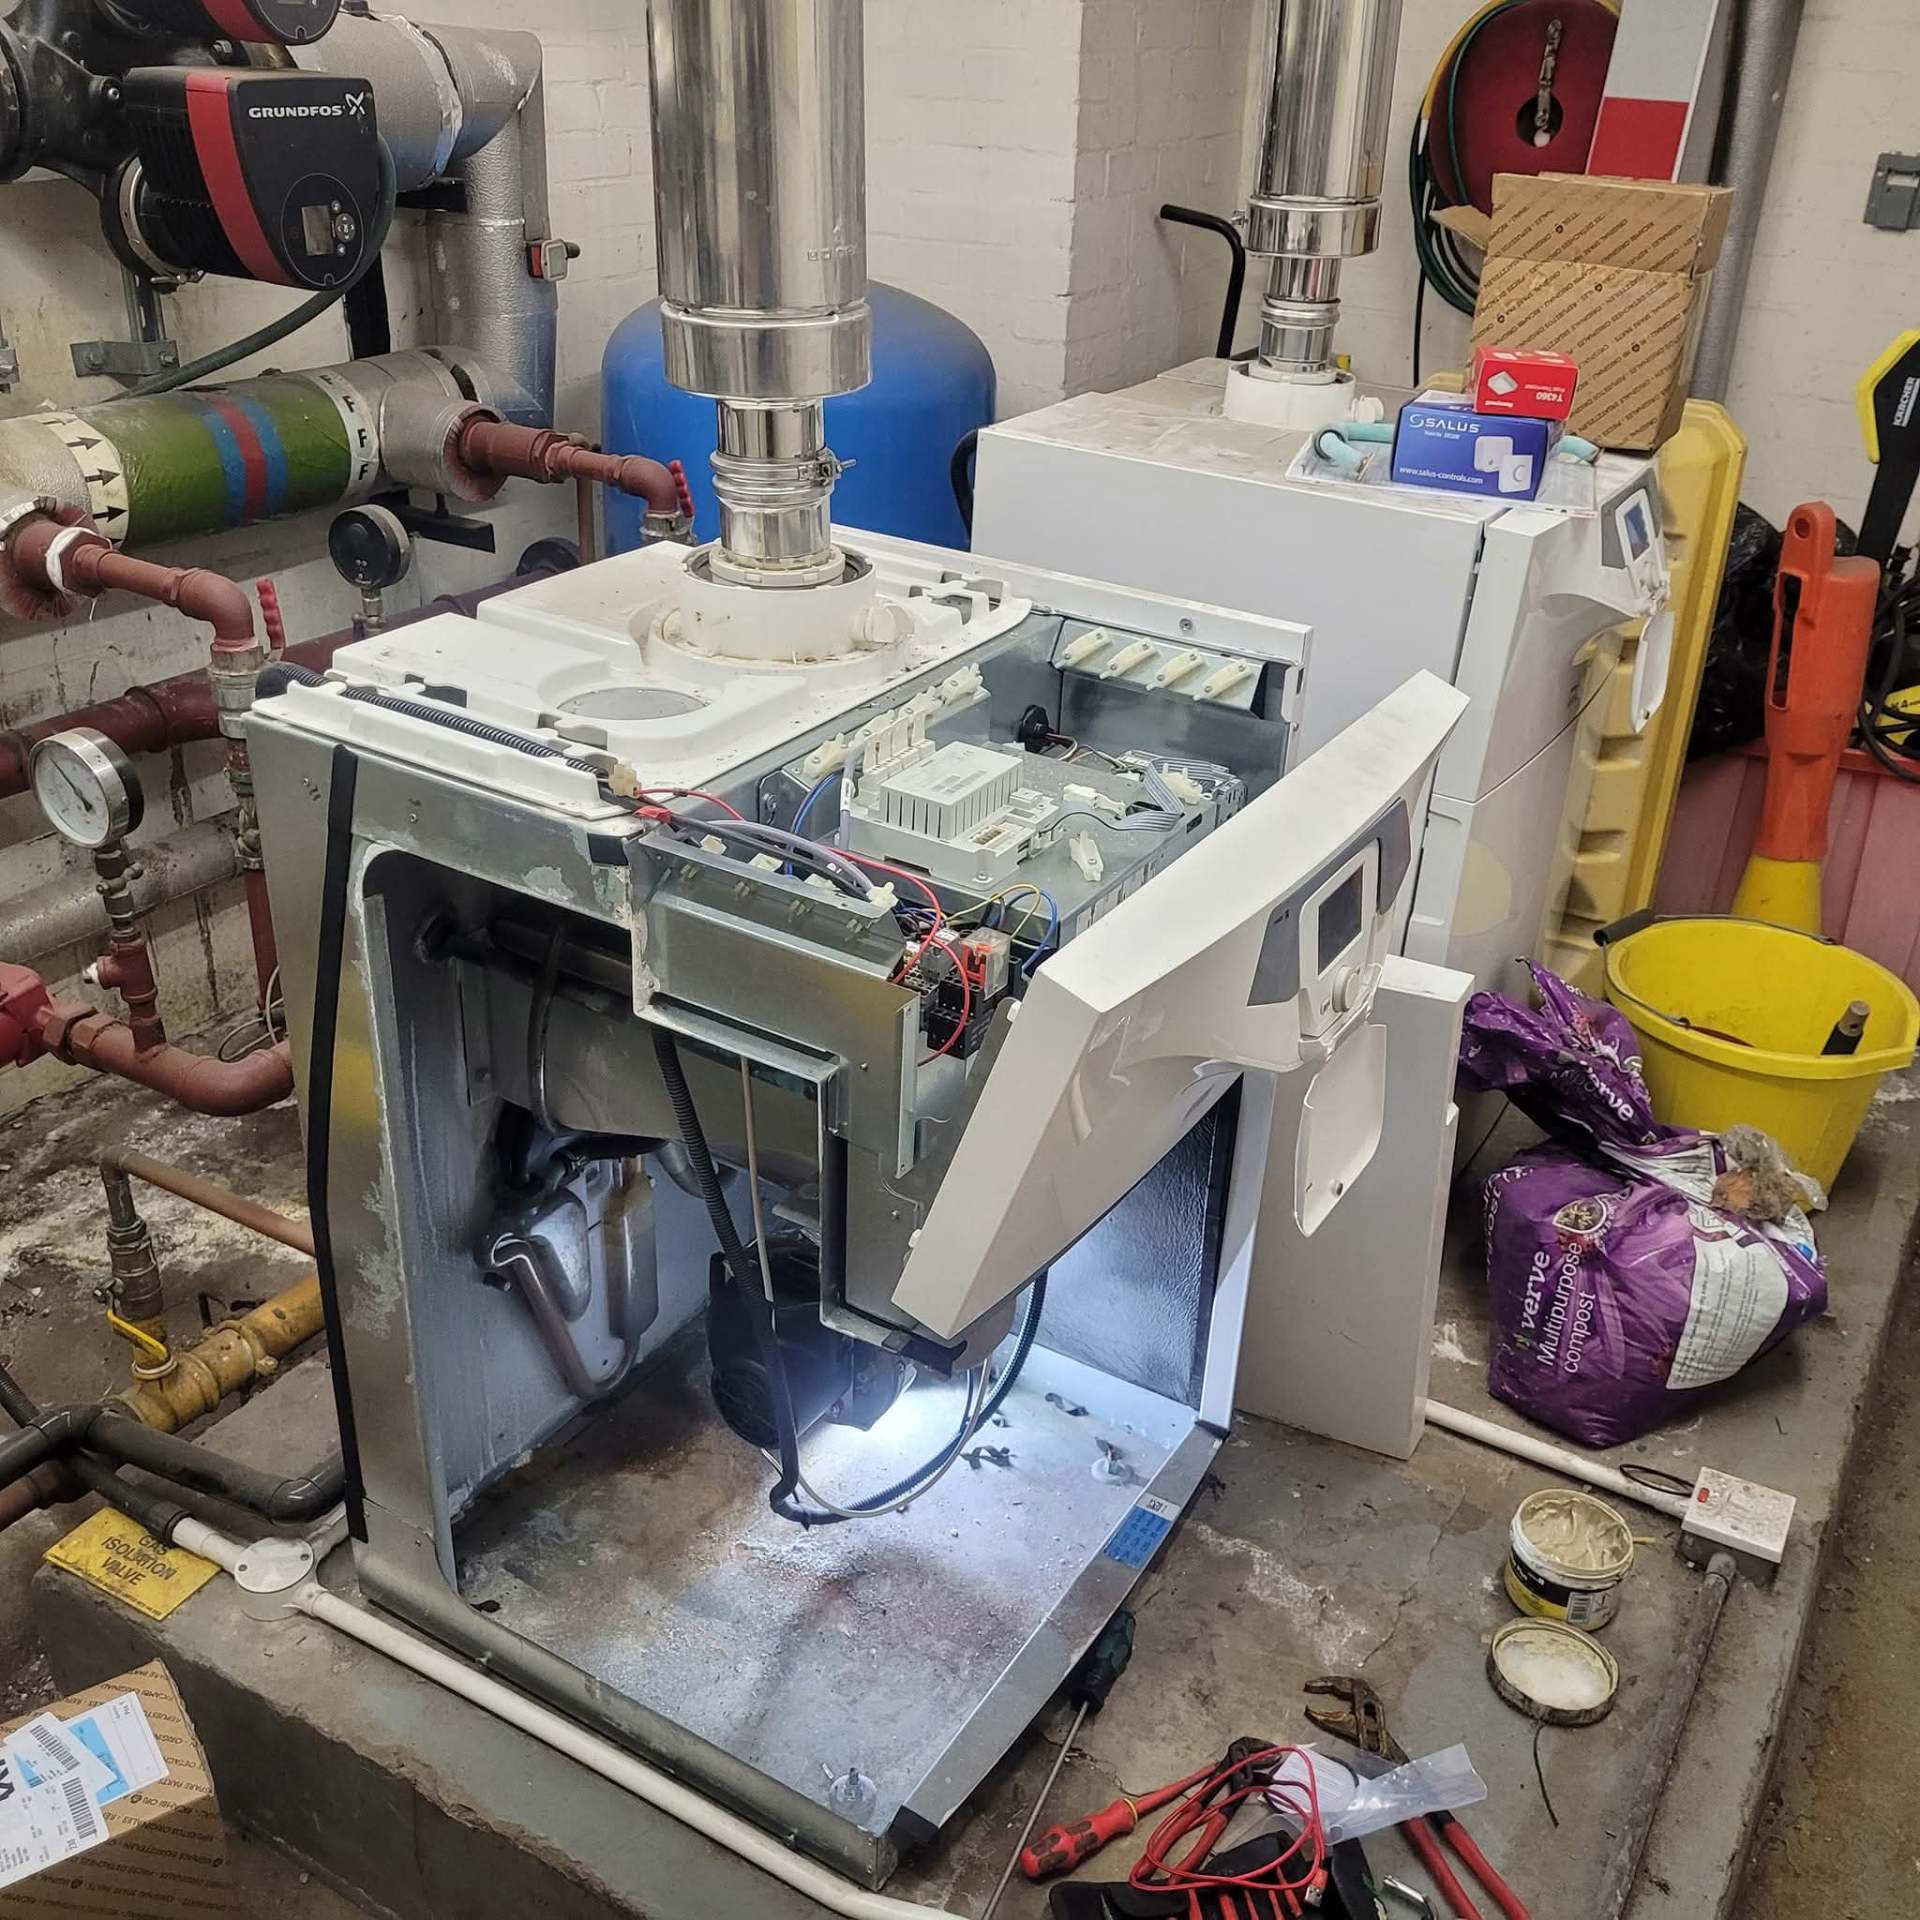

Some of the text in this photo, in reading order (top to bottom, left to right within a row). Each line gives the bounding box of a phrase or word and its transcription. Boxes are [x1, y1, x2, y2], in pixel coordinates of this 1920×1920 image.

[249, 105, 343, 118] GRUNDFOS
[1425, 417, 1481, 433] SALUS
[358, 429, 367, 448] F
[359, 463, 368, 480] F
[1399, 466, 1484, 485] www.salus-controls.com
[1522, 1251, 1550, 1330] verve
[1536, 1242, 1583, 1366] Multipurpose
[1563, 1290, 1596, 1373] compost
[138, 1535, 169, 1556] GAS
[101, 1536, 178, 1580] ISOLATION
[100, 1557, 147, 1586] VALVE
